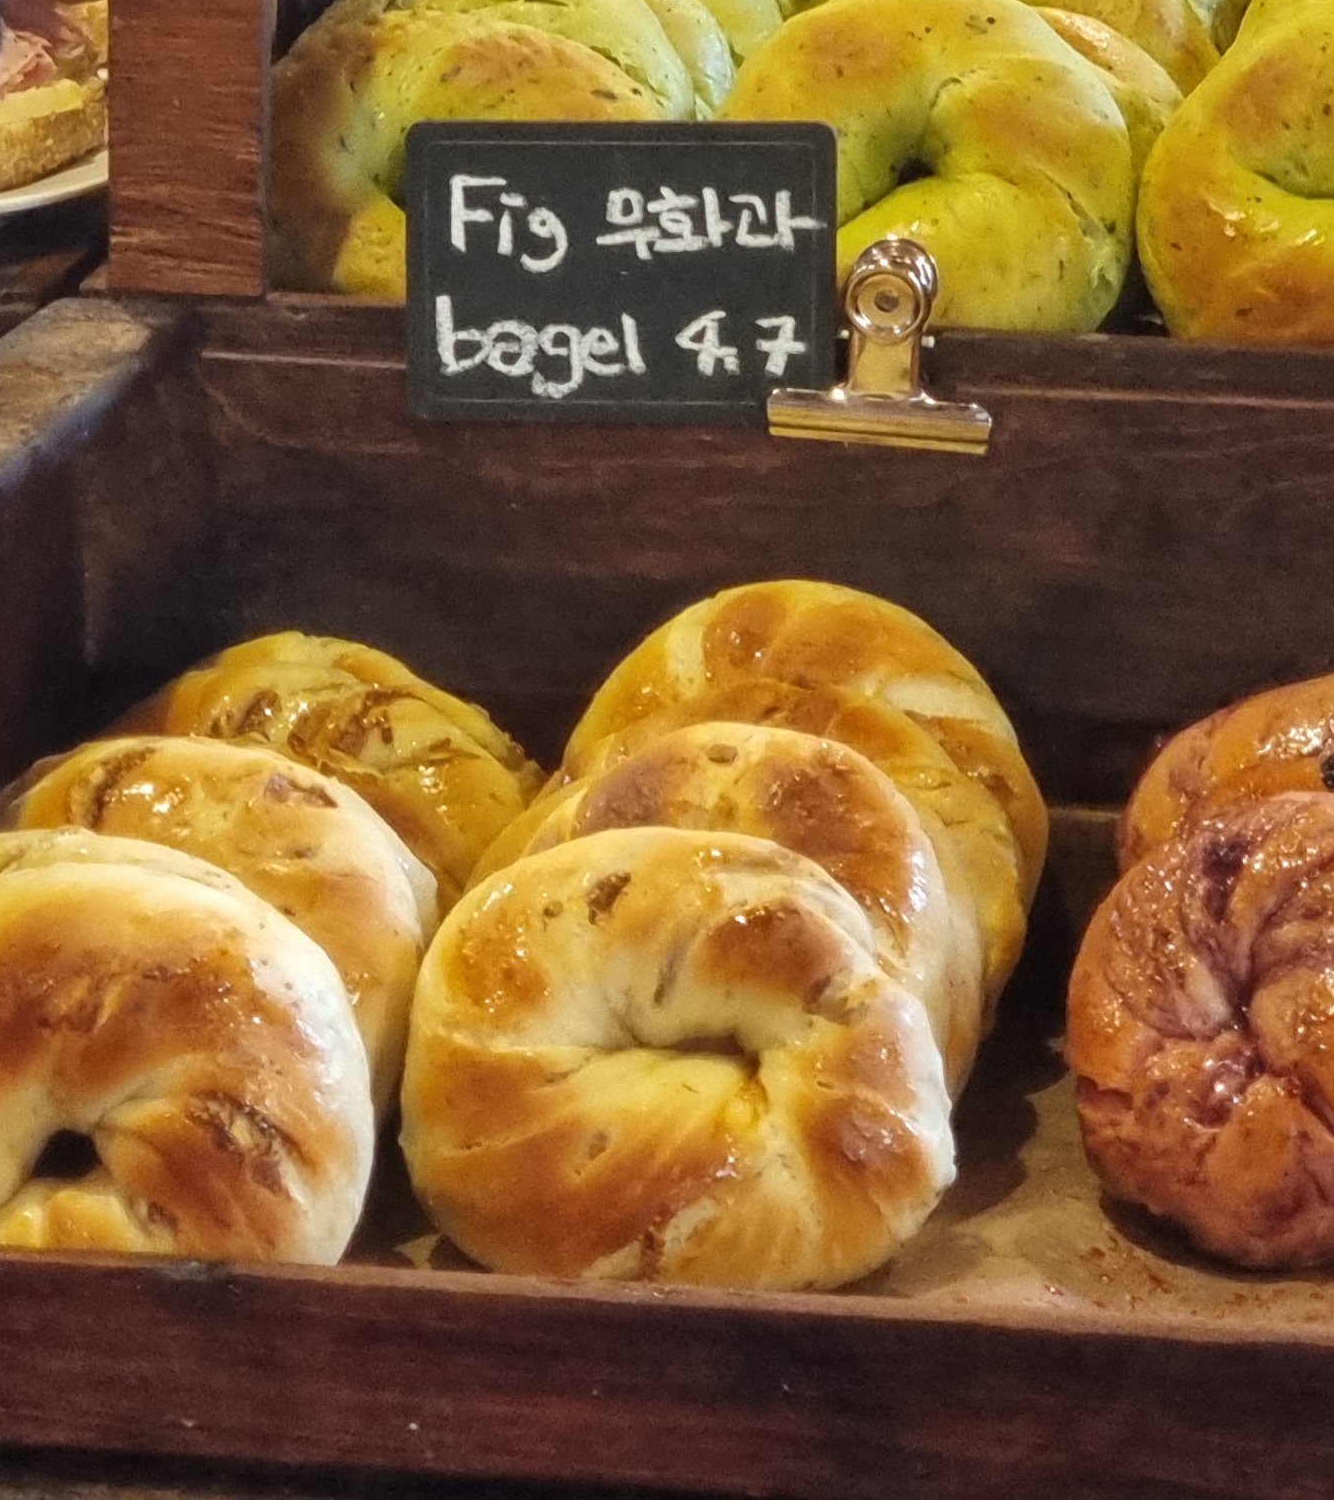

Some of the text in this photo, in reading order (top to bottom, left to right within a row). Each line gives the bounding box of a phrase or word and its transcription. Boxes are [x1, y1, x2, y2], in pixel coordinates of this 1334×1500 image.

[449, 173, 828, 274] Fig 무화과
[435, 294, 807, 399] bagel 4.7
